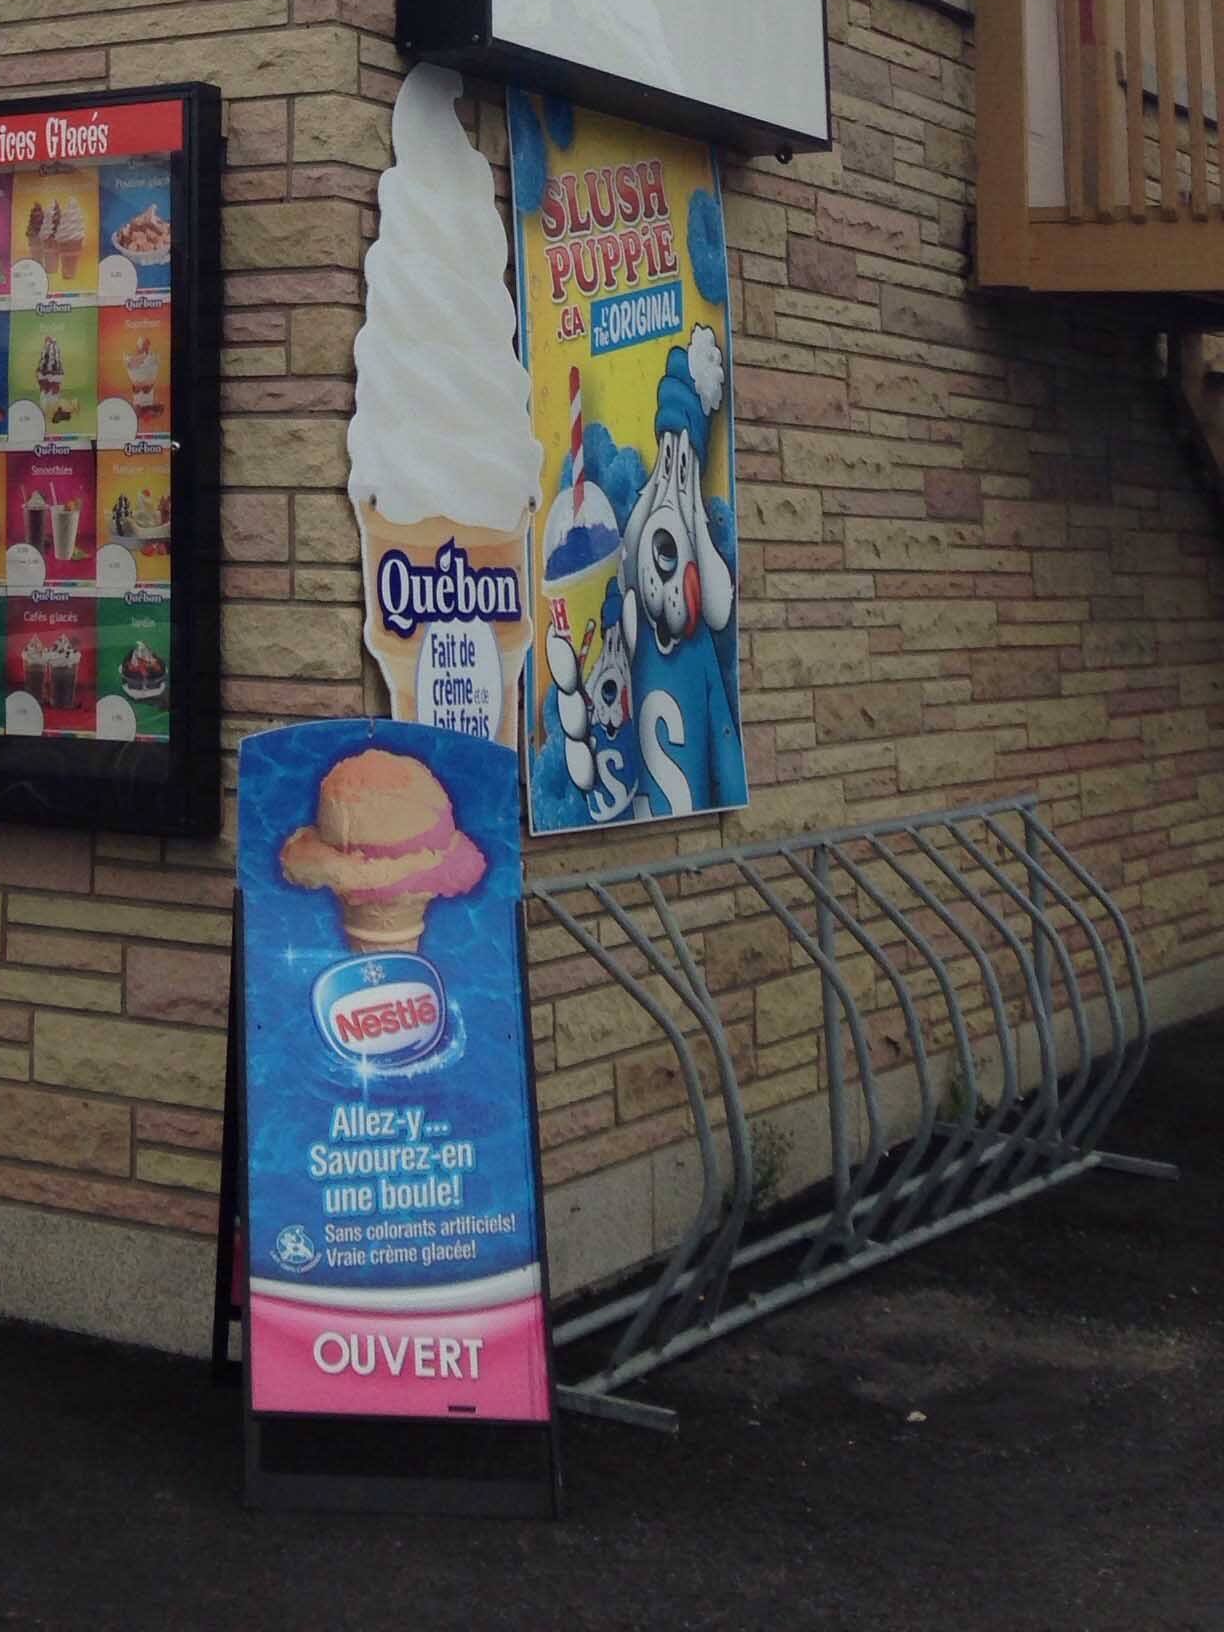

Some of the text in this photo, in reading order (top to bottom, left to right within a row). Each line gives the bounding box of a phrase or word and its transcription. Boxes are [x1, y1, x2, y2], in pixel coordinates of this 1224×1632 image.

[45, 111, 109, 159] Glacés
[541, 160, 669, 241] SLUSH
[593, 288, 680, 348] The ORIGINAL
[31, 465, 73, 475] Smoothies
[380, 548, 519, 630] Québon
[23, 610, 79, 625] Cafés glacés
[431, 632, 475, 668] Fait de
[432, 671, 473, 706] crème
[335, 992, 438, 1044] Nestlé
[310, 1142, 473, 1178] Savourez-en
[325, 1176, 463, 1213] une boule!
[325, 1213, 516, 1243] Sans colorants artificiels!
[326, 1246, 367, 1267] Vraie
[370, 1243, 418, 1264] crème
[421, 1240, 477, 1267] glacée!
[313, 1330, 484, 1380] OUVERT
